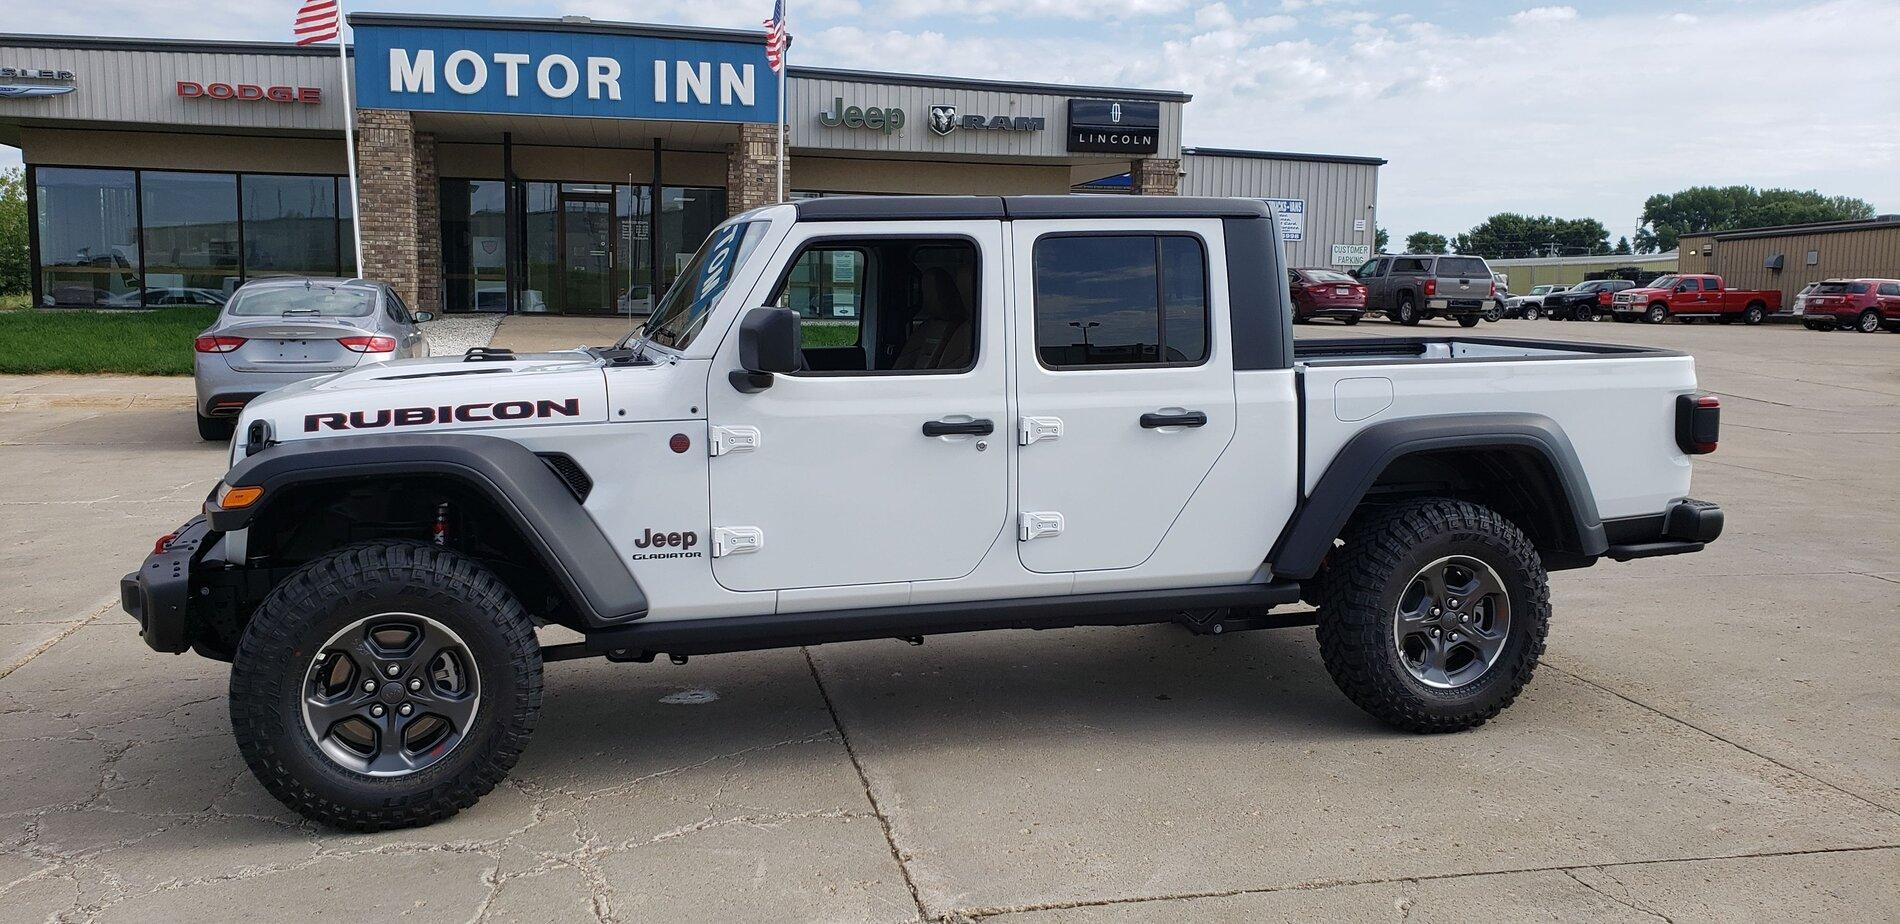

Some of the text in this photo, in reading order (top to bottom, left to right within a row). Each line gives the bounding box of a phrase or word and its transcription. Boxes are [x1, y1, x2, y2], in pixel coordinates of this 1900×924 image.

[389, 47, 755, 107] MOTOR INN
[176, 81, 322, 105] DODGE
[819, 97, 906, 135] Jeep
[962, 114, 1045, 132] RAM
[1078, 133, 1152, 146] LINCOLN
[1333, 245, 1368, 254] CUSTOMER
[1337, 256, 1364, 264] PARKING
[303, 398, 580, 433] RUBICON
[634, 528, 698, 550] Jeep
[632, 551, 703, 561] GLADIATOR
